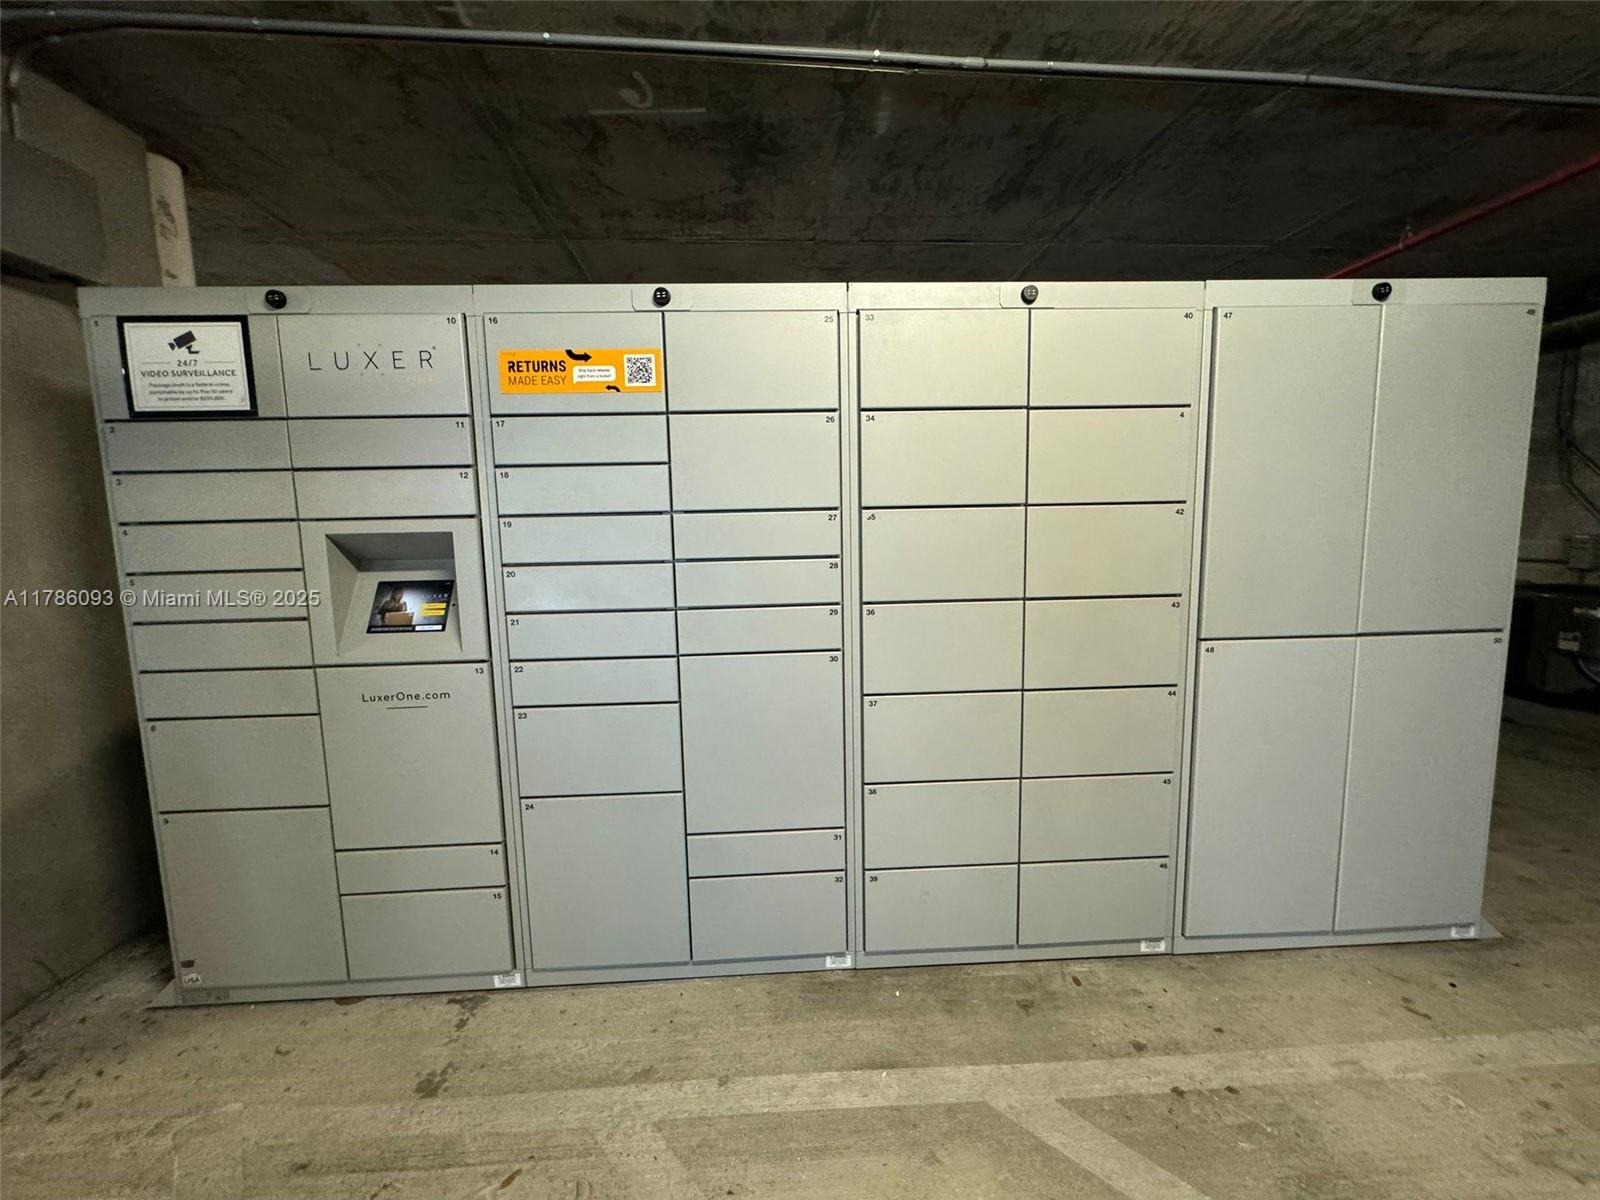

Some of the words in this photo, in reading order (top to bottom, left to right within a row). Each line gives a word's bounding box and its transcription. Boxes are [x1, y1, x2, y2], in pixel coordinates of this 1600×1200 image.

[177, 359, 198, 367] 24/7
[507, 360, 567, 373] RETURNS
[140, 370, 169, 378] VIDEO
[171, 369, 237, 377] SURVEILLANCE
[507, 376, 538, 386] MADE
[541, 375, 567, 385] EASY
[361, 692, 451, 703] LuxerOne.com
